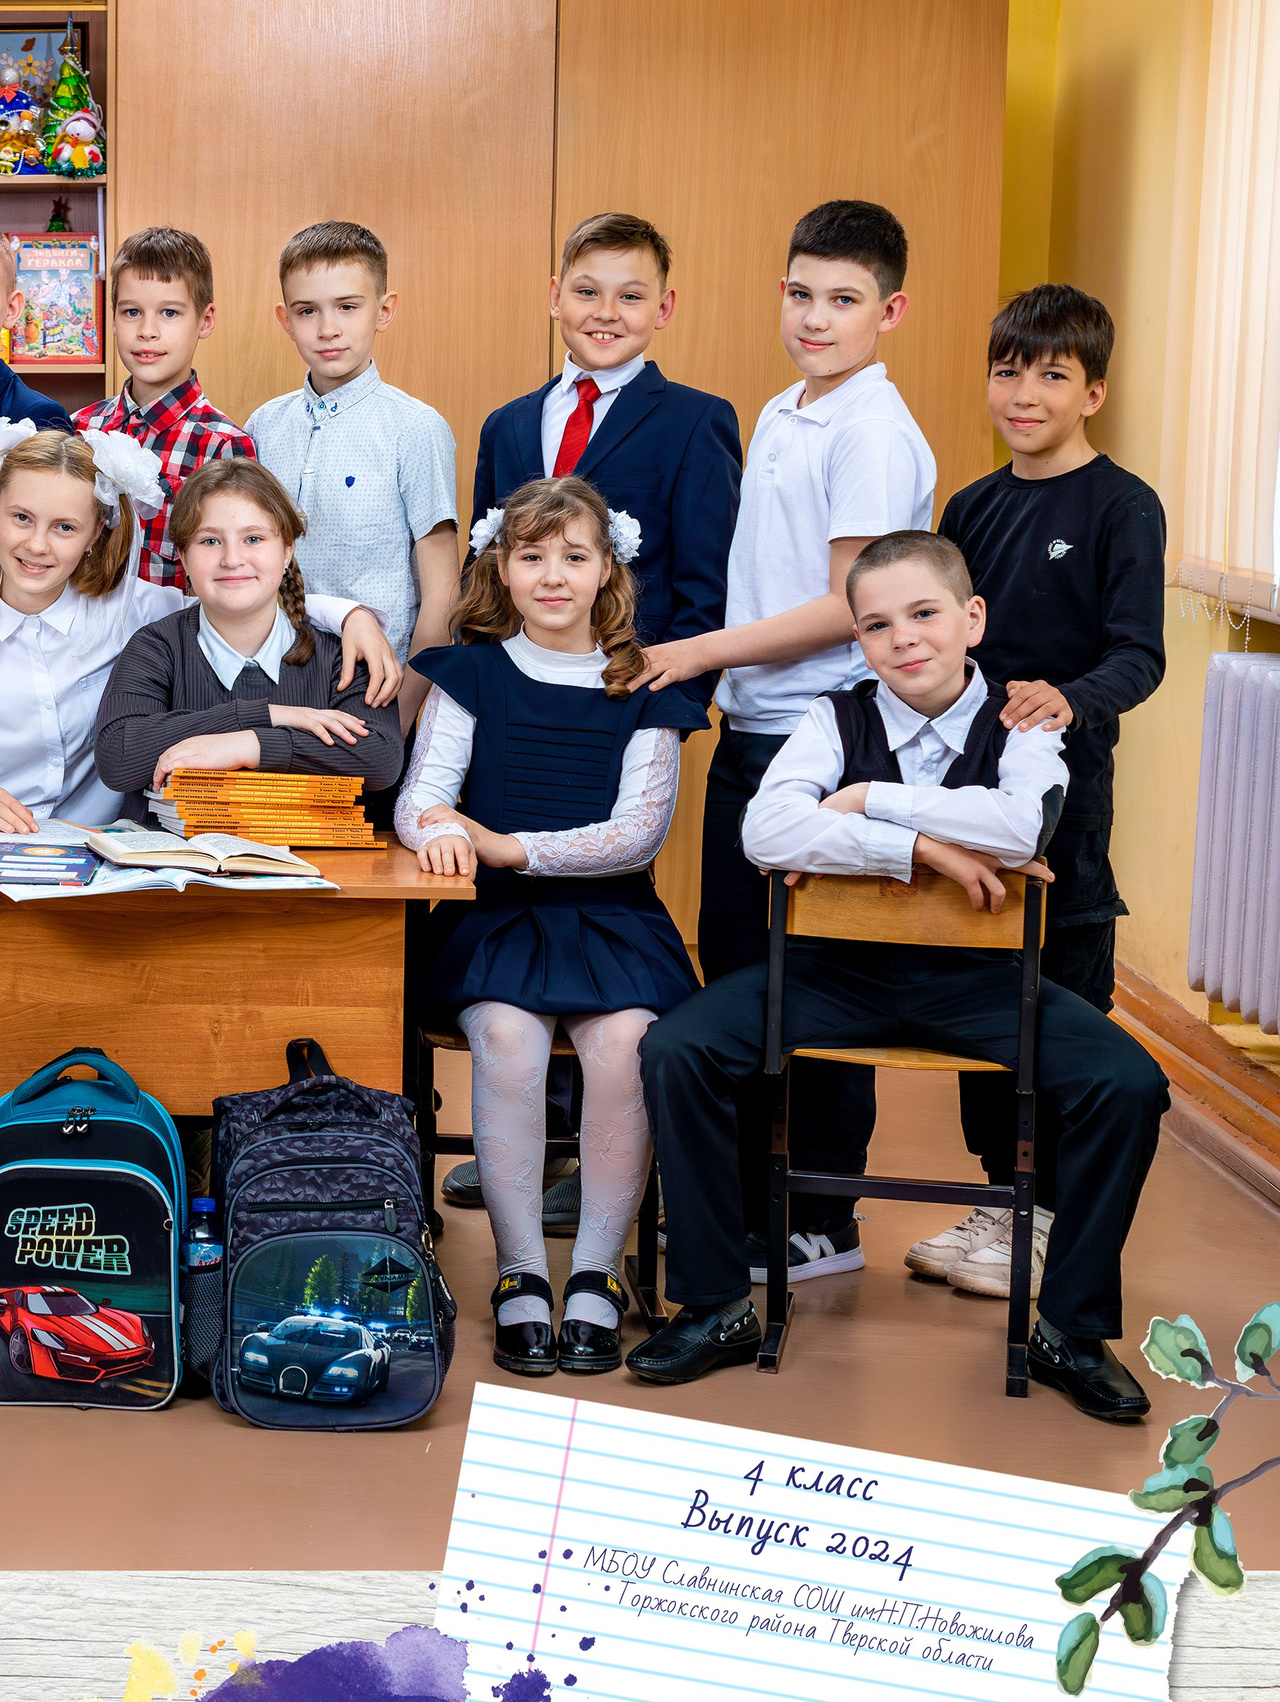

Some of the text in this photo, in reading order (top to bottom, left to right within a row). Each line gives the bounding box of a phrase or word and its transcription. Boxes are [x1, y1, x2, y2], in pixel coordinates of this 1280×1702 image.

[28, 258, 83, 268] ГЕРАКЛА
[5, 1203, 96, 1238] SPEED
[15, 1235, 131, 1275] POWER
[198, 1256, 223, 1267] Arcti
